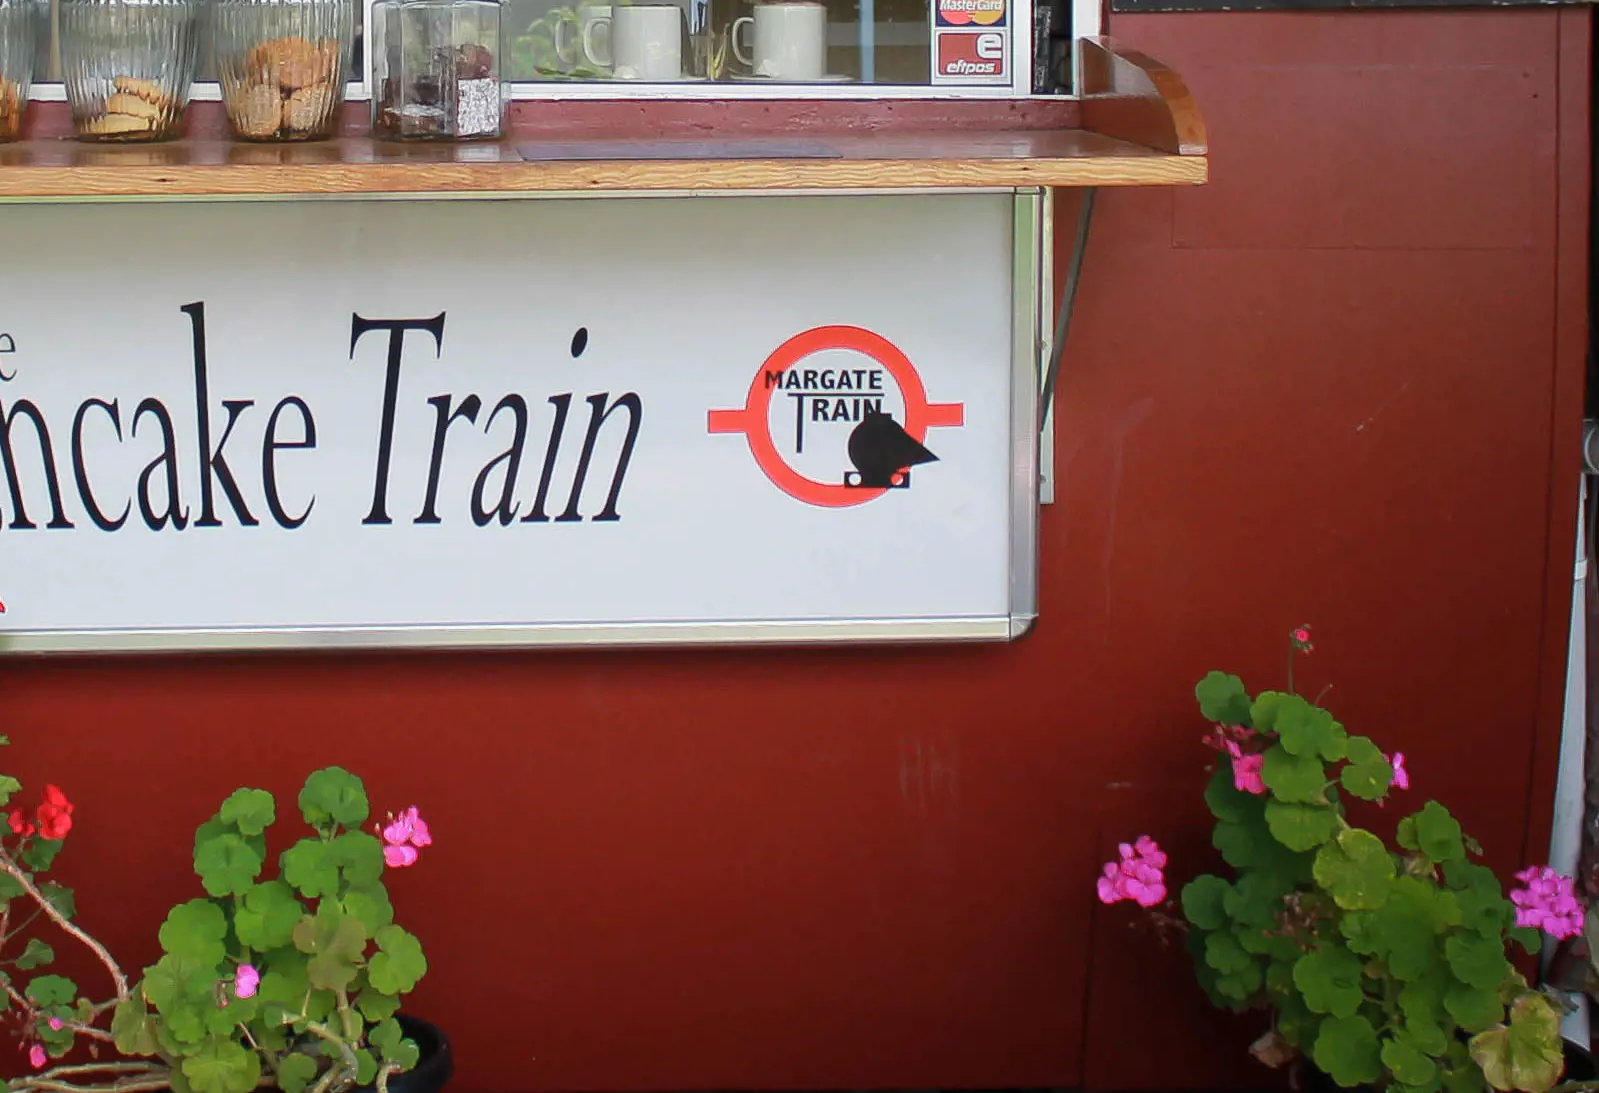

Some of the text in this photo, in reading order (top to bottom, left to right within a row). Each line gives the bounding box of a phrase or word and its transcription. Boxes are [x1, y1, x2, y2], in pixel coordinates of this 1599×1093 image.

[946, 59, 996, 75] eftpos
[765, 369, 883, 390] MARGATE
[349, 310, 644, 528] Train
[787, 392, 885, 454] TRAIN
